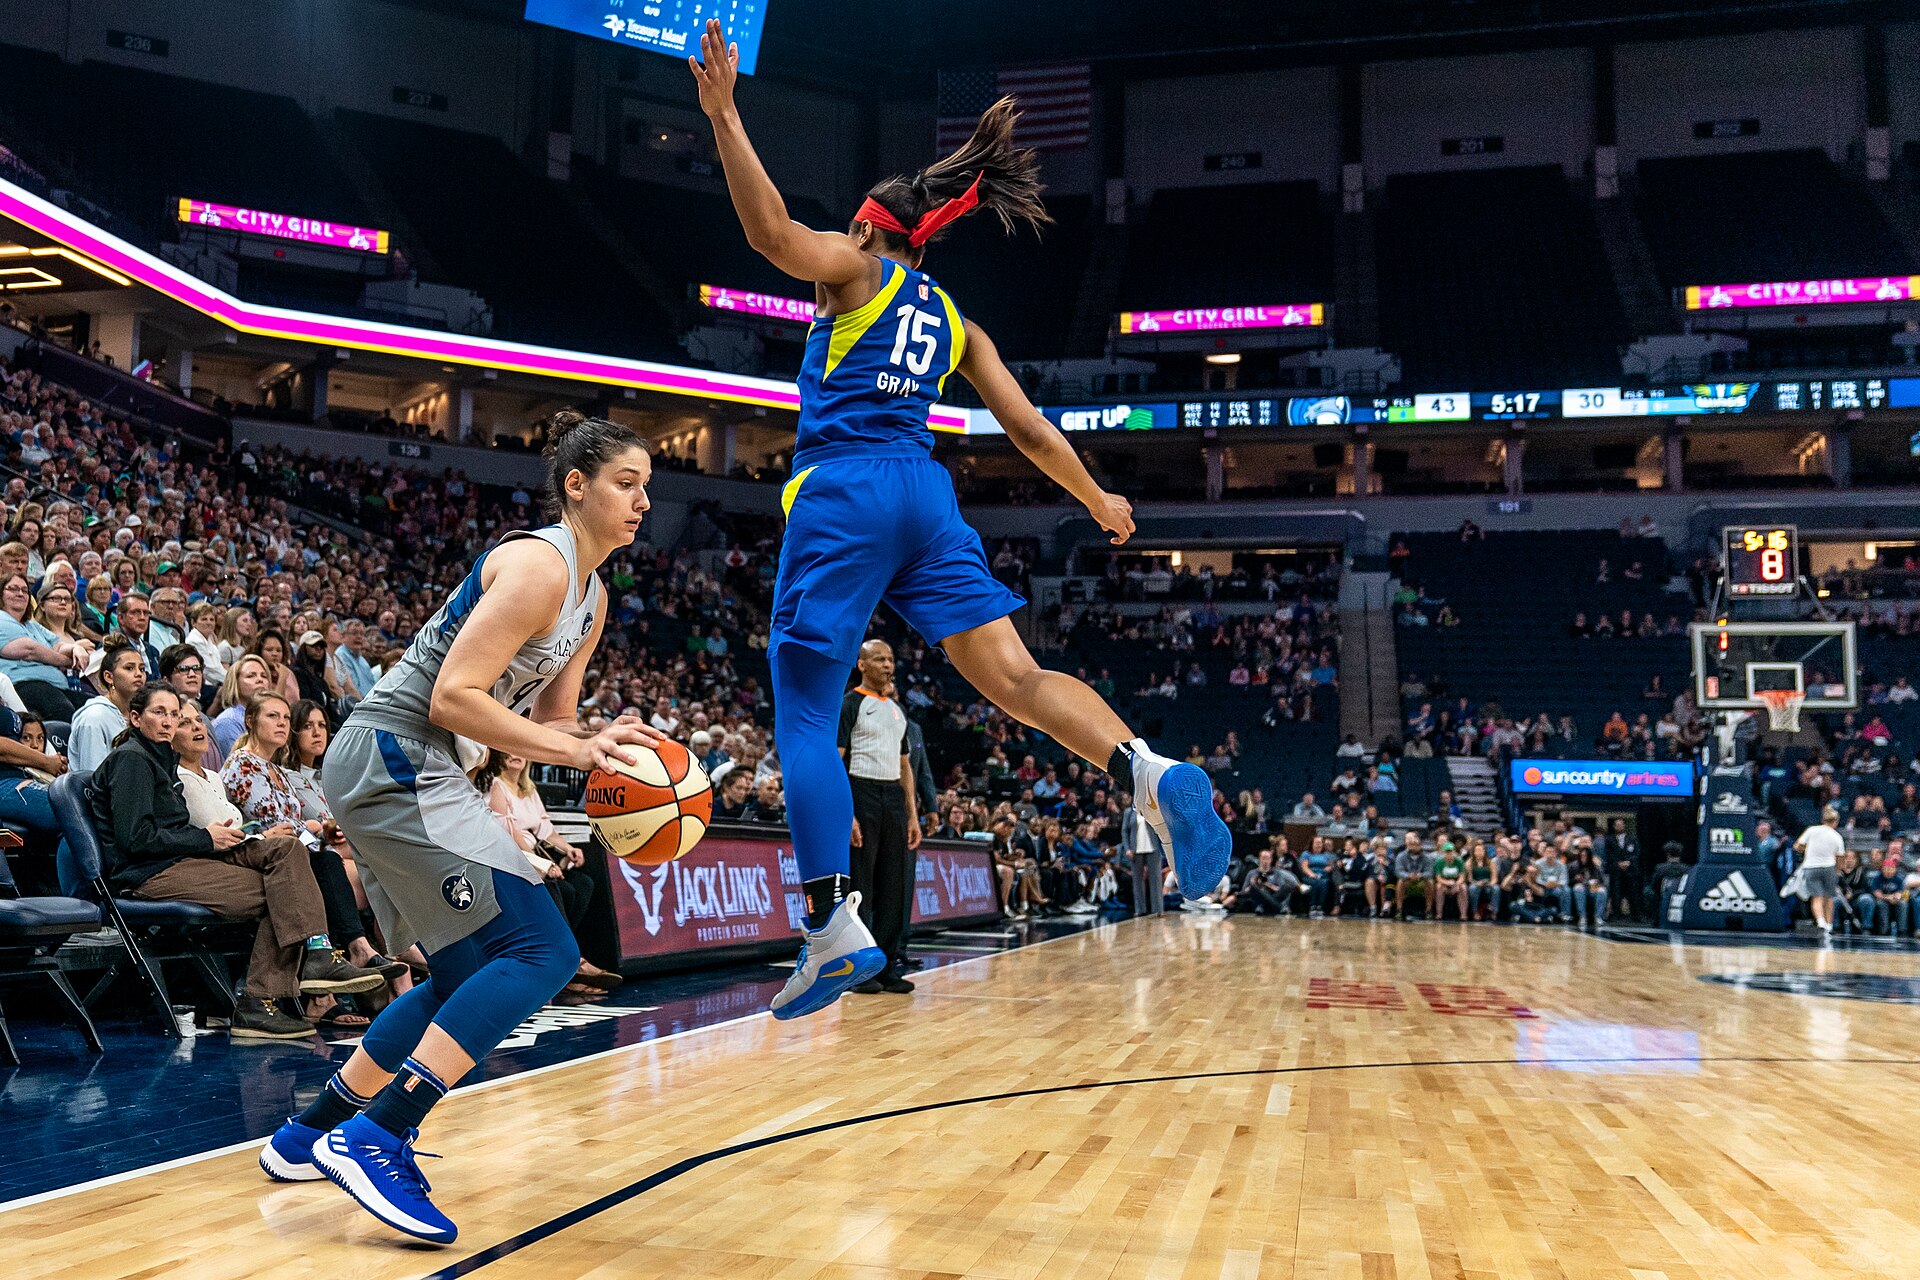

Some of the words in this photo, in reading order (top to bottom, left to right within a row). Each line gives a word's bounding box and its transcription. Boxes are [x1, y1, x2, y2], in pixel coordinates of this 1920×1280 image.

[627, 18, 661, 38] Treasure
[662, 27, 687, 45] Island
[236, 209, 283, 229] CITY
[287, 217, 334, 239] GIRL
[261, 228, 294, 238] COFFEE
[1746, 282, 1801, 299] CITY
[1804, 280, 1858, 296] GIRL
[745, 292, 784, 311] CITY
[786, 300, 817, 317] GIR
[1173, 309, 1217, 324] CITY
[1222, 306, 1267, 322] GIRL
[889, 303, 941, 375] 15
[1431, 398, 1455, 412] 43
[1491, 393, 1541, 414] 5:17
[1579, 393, 1604, 409] 30
[1060, 410, 1101, 431] GET
[1102, 405, 1131, 427] UP
[1744, 530, 1788, 551] 5:16
[1761, 548, 1784, 580] 8
[1749, 583, 1795, 593] TISSOT
[1625, 772, 1679, 786] airlines
[672, 860, 726, 927] JACK
[717, 860, 771, 919] LINK'S
[1699, 898, 1767, 914] adidas
[697, 926, 730, 942] PROTEIN
[732, 923, 759, 938] SNACKS
